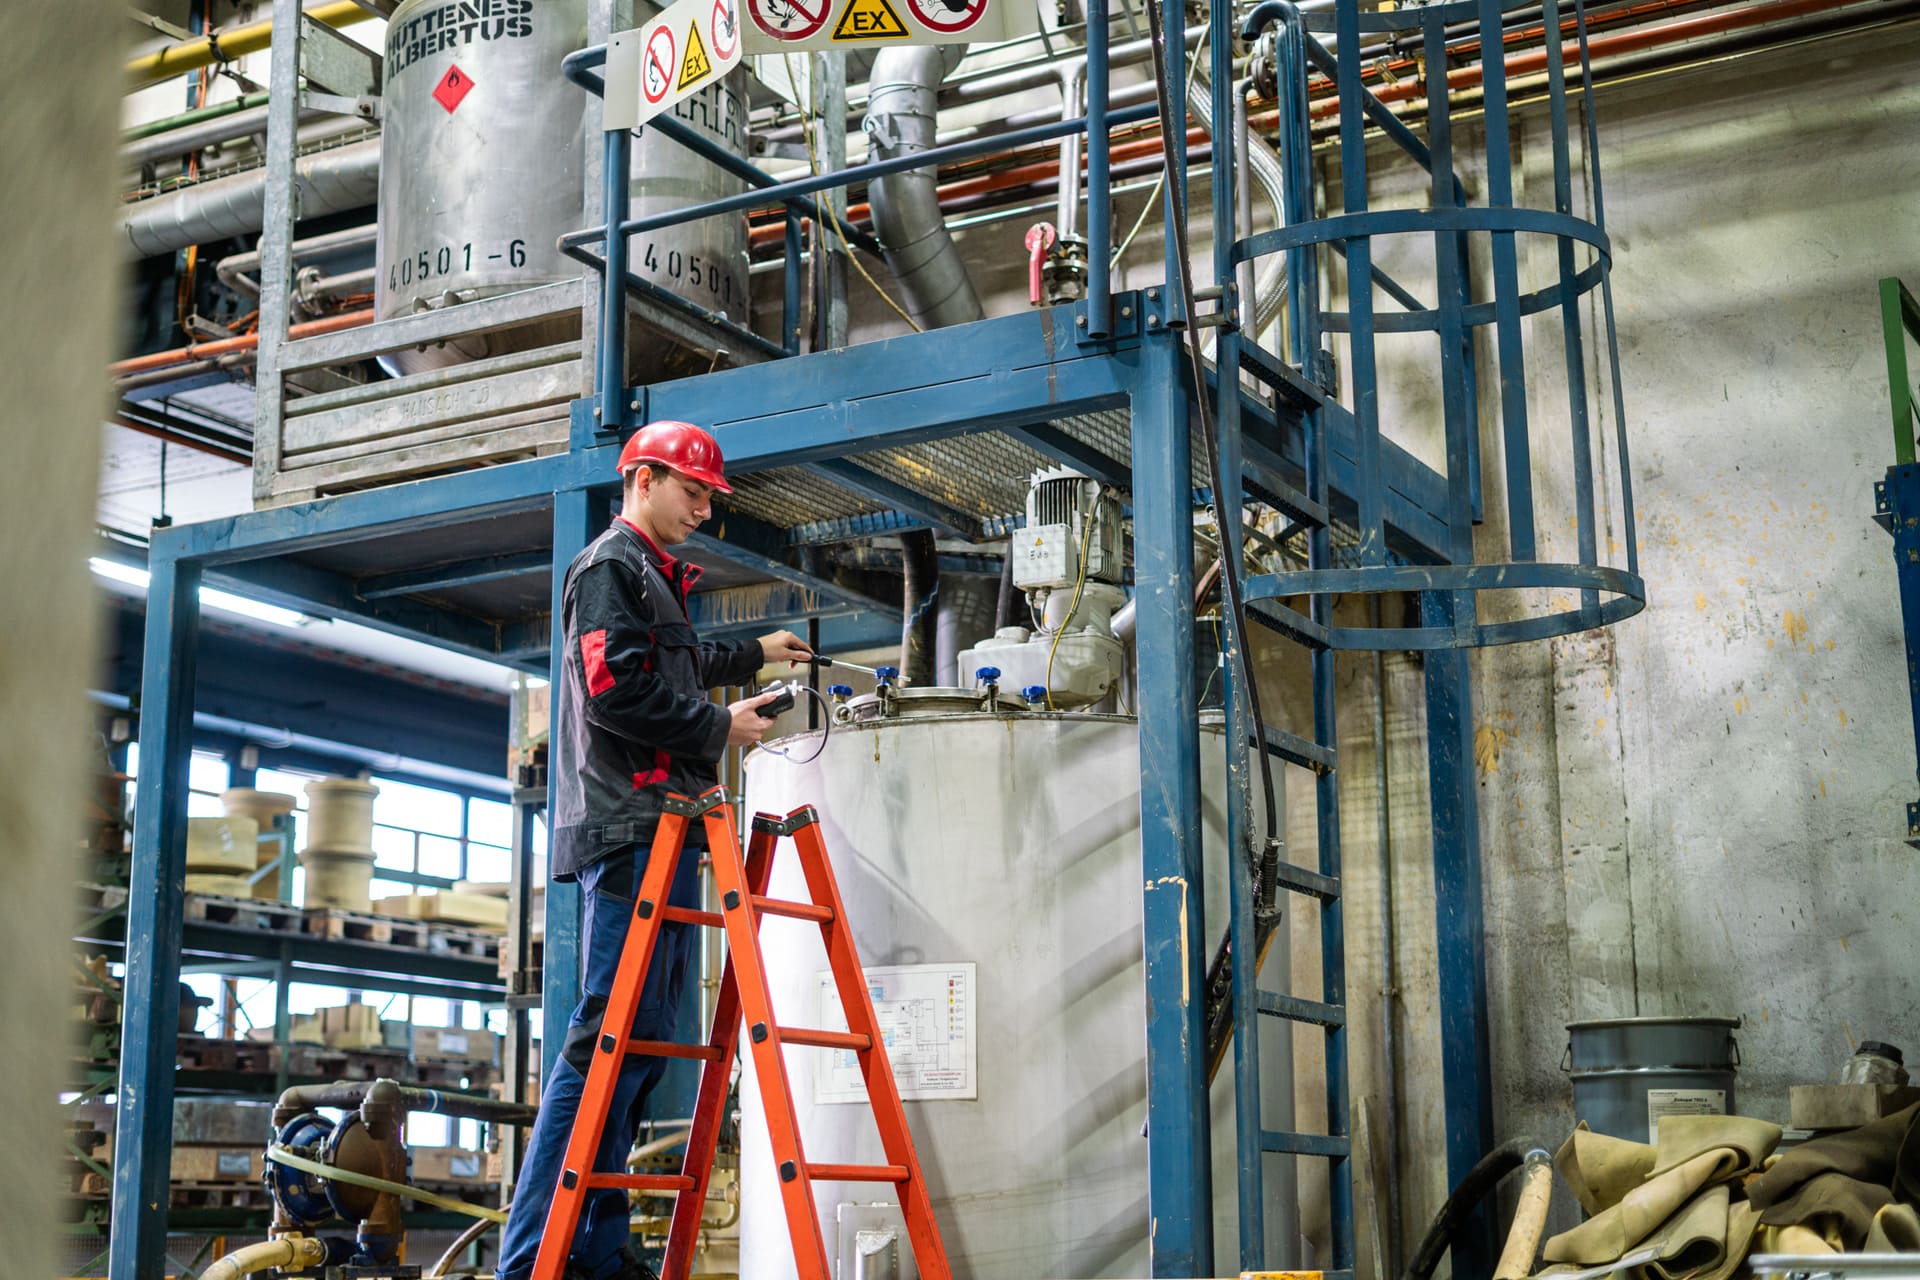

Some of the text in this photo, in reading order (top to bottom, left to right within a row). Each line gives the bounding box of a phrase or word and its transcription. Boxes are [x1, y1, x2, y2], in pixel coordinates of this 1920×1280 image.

[387, 0, 533, 62] HÜTTENES
[387, 16, 533, 85] ALBERTUS
[853, 11, 887, 31] EX
[686, 53, 702, 77] EX
[644, 243, 731, 304] 40501
